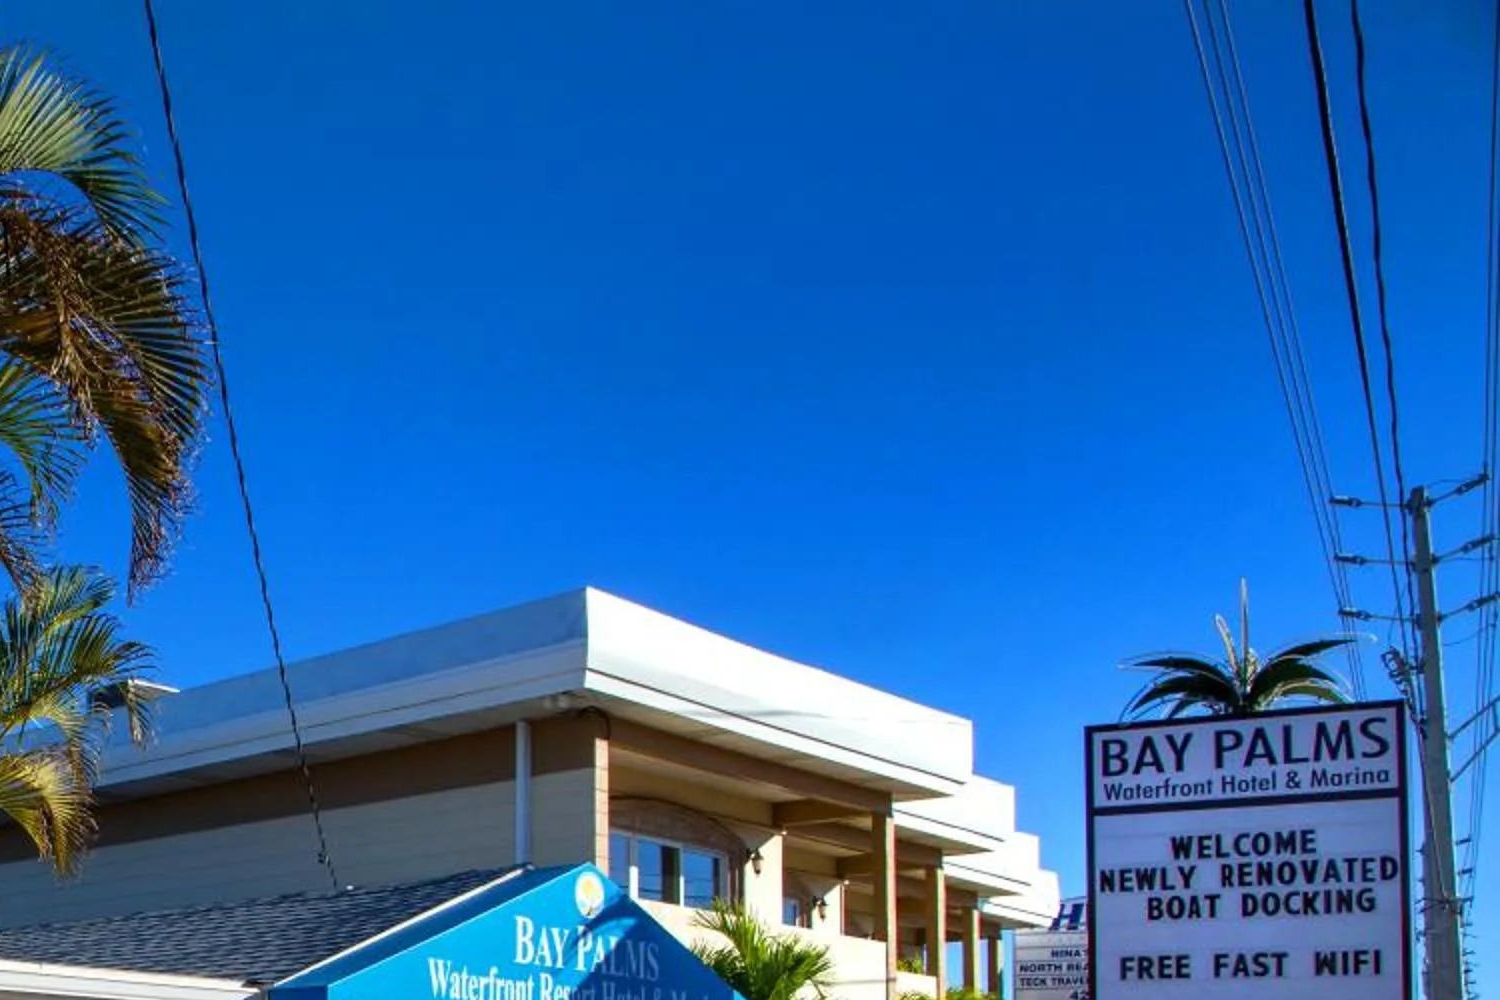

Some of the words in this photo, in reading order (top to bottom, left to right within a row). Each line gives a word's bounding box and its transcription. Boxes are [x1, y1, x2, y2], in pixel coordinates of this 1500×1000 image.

[1101, 732, 1194, 777] BAY
[1213, 716, 1390, 769] PALMS
[1103, 777, 1212, 801] Waterfront
[1221, 770, 1277, 795] Hotel
[1286, 771, 1301, 790] &
[1310, 767, 1390, 788] Marina
[1170, 829, 1317, 860] WELCOME
[1100, 865, 1197, 893] NEWLY
[1220, 855, 1399, 888] RENOVATED
[1147, 894, 1221, 921] BOAT
[1242, 887, 1376, 917] DOCKING
[514, 915, 569, 969] BAY
[574, 925, 660, 982] PALMS
[1120, 954, 1191, 981] FREE
[1213, 952, 1288, 978] FAST
[1315, 949, 1381, 977] WIFI
